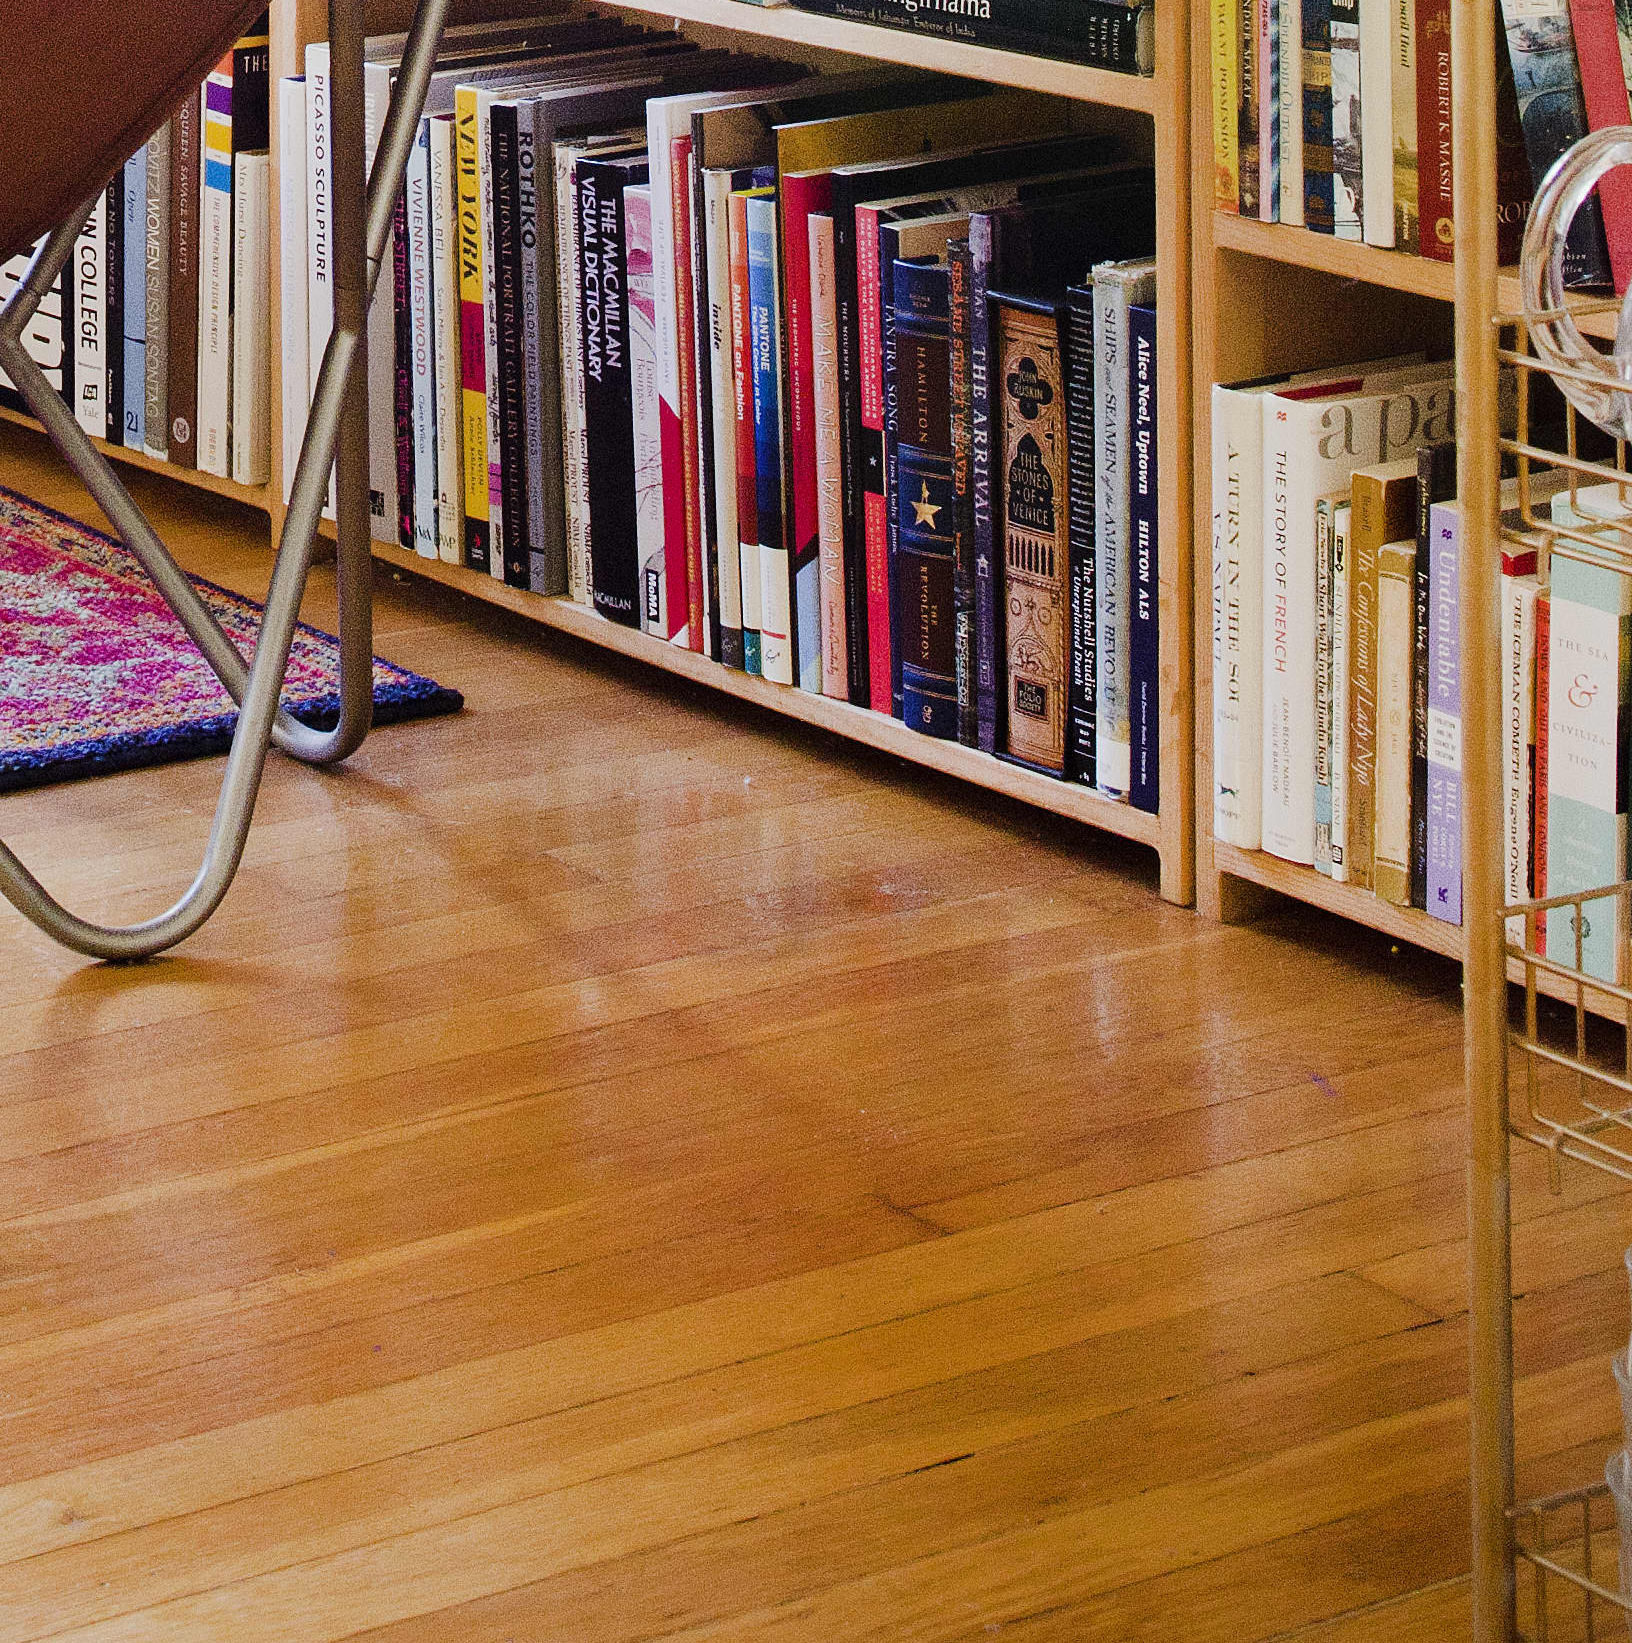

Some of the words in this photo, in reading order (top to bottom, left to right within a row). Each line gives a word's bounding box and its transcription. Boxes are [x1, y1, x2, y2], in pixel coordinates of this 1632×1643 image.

[314, 74, 325, 161] PICASSO
[459, 107, 476, 176] NEW
[499, 132, 508, 161] THE
[432, 149, 444, 222] VANESSA
[499, 169, 513, 262] NATIONAL
[519, 131, 537, 249] ROTHKO
[580, 176, 598, 247] VISUAL
[600, 198, 617, 235] THE
[315, 167, 327, 284] SCULPTURE
[413, 178, 425, 261] VIVIENNE
[435, 227, 445, 261] BELL
[462, 193, 479, 280] YORK
[79, 235, 99, 353] COLLEGE
[414, 267, 427, 377] WESTWOOD
[502, 264, 516, 351] PORTRAIT
[583, 252, 603, 383] DICTIONARY
[602, 237, 622, 369] MACMILLAN
[711, 303, 722, 351] Inside
[758, 306, 770, 372] PANTONE
[814, 317, 833, 395] MAKE
[884, 303, 898, 373] TANTRA
[1103, 307, 1116, 369] SHIPS
[1136, 335, 1150, 380] Alice
[506, 357, 519, 440] GALLERY
[916, 346, 929, 443] HAMILTON
[972, 346, 987, 399] THE
[1136, 384, 1150, 426] Neel,
[818, 406, 837, 444] ME
[887, 382, 899, 432] SONG
[1104, 392, 1117, 474] SEAMEN
[819, 451, 835, 466] A
[972, 410, 989, 532] ARRIVAL
[1011, 468, 1049, 493] STONES
[1019, 451, 1039, 469] THE
[1137, 430, 1150, 495] Uptown
[1275, 450, 1287, 487] THE
[507, 444, 521, 548] COLLECTION
[1012, 502, 1049, 527] VENICE
[1274, 494, 1287, 560] STORY
[820, 476, 842, 586] WOMAN
[1137, 518, 1150, 583] HILTON
[646, 570, 659, 618] MoMA
[1081, 557, 1094, 583] The
[1104, 512, 1118, 616] AMERICAN
[1274, 563, 1287, 590] OF
[919, 565, 929, 661] REVOLUTION
[930, 604, 939, 627] THE
[1071, 575, 1082, 652] Unexplained
[1082, 585, 1096, 649] Nutshell
[1138, 587, 1150, 621] ALS
[1275, 593, 1287, 672] FRENCH
[1436, 551, 1457, 699] Undeniable
[1513, 596, 1523, 634] THE
[1073, 655, 1083, 686] Death
[1083, 651, 1096, 702] Studies
[1511, 636, 1522, 702] ICEMAN
[1556, 638, 1583, 654] THE
[1587, 644, 1610, 662] SEA
[1018, 689, 1043, 705] FOLIO
[1022, 682, 1036, 696] THE
[1511, 706, 1521, 786] COMETH
[1552, 721, 1613, 747] CIVILIZA-
[1567, 752, 1598, 770] TION
[1445, 781, 1458, 826] BILL
[1509, 792, 1520, 845] Eugene
[1509, 845, 1520, 900] O'Neill
